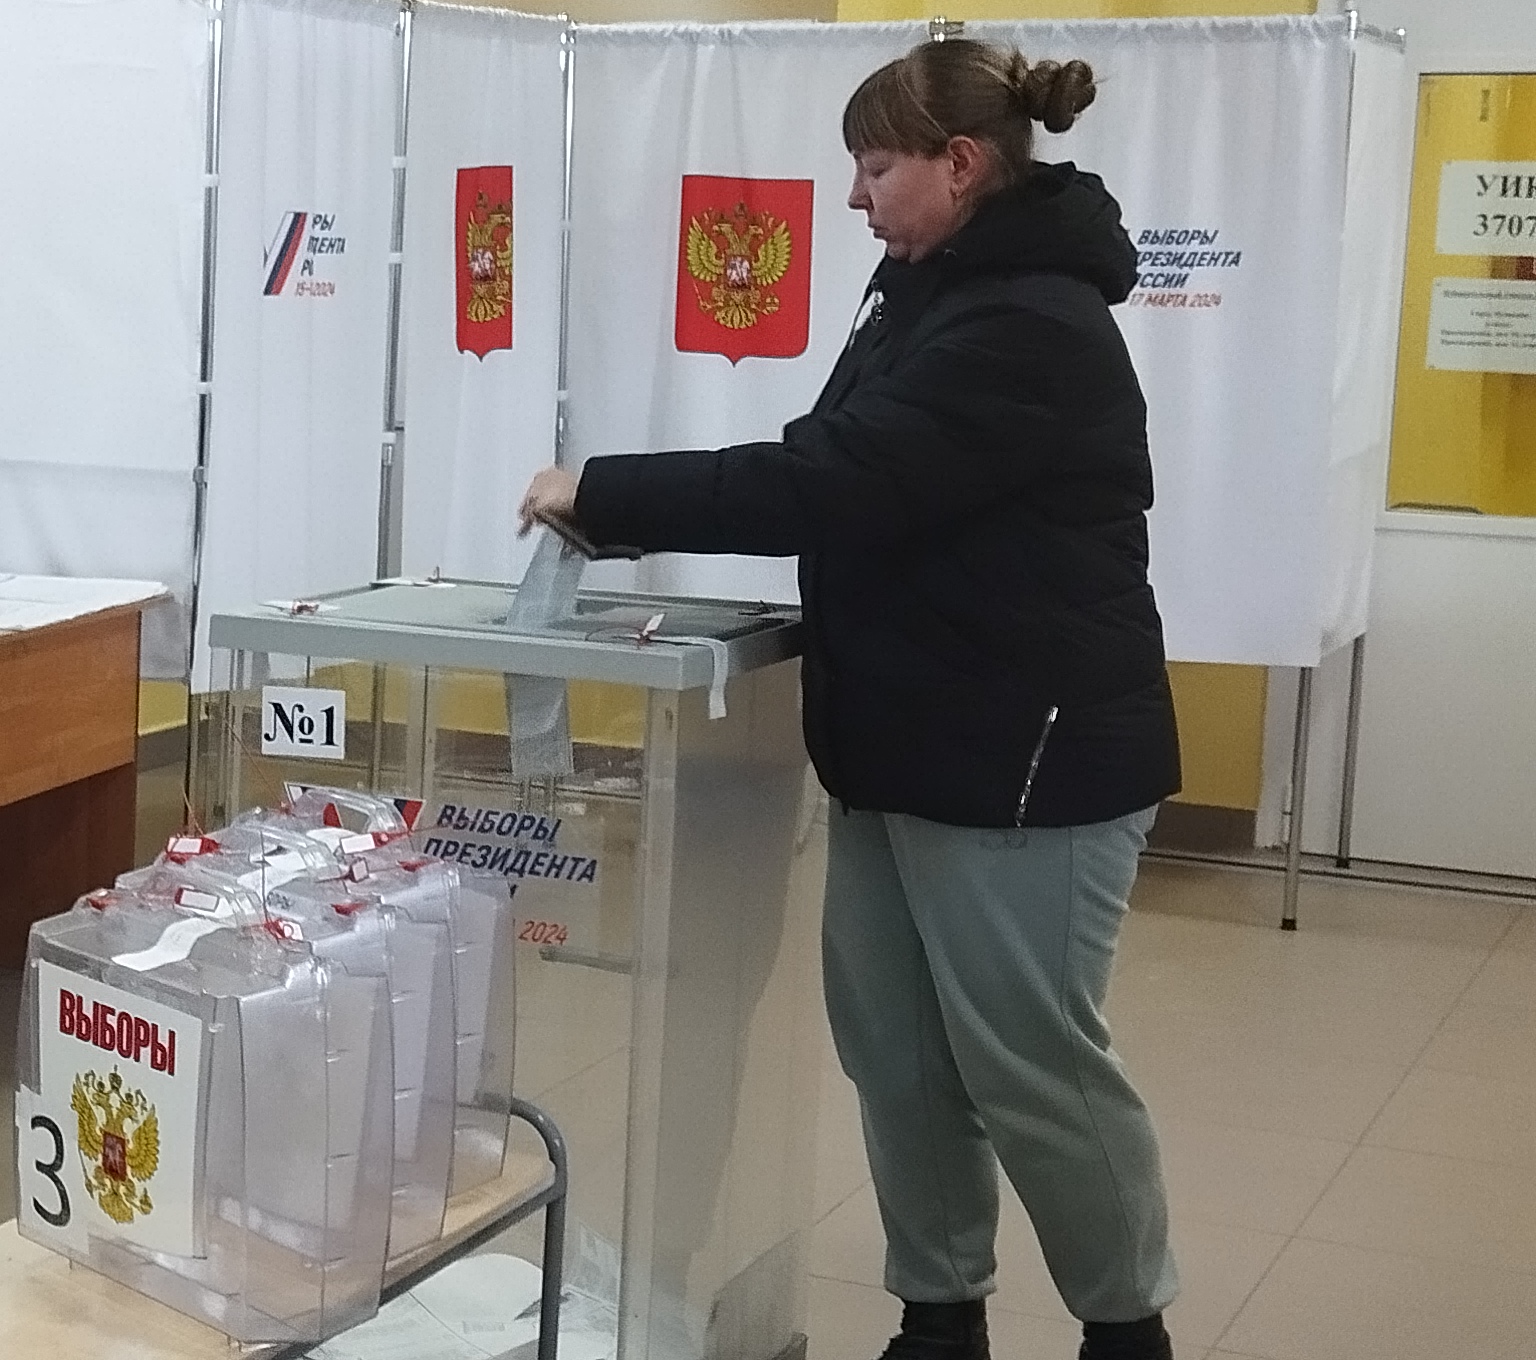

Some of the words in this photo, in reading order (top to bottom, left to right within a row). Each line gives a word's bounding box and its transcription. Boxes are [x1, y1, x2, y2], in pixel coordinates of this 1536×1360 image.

[1138, 229, 1219, 246] ВЫБОРЫ
[1137, 273, 1189, 289] ССИИ
[263, 701, 338, 746] №1
[436, 804, 563, 842] ВЫБОРЫ
[424, 837, 599, 884] ПРЕЗИДЕНТА
[518, 920, 569, 946] 2024
[59, 987, 177, 1077] ВЫБОРЫ
[29, 1115, 72, 1227] 3
